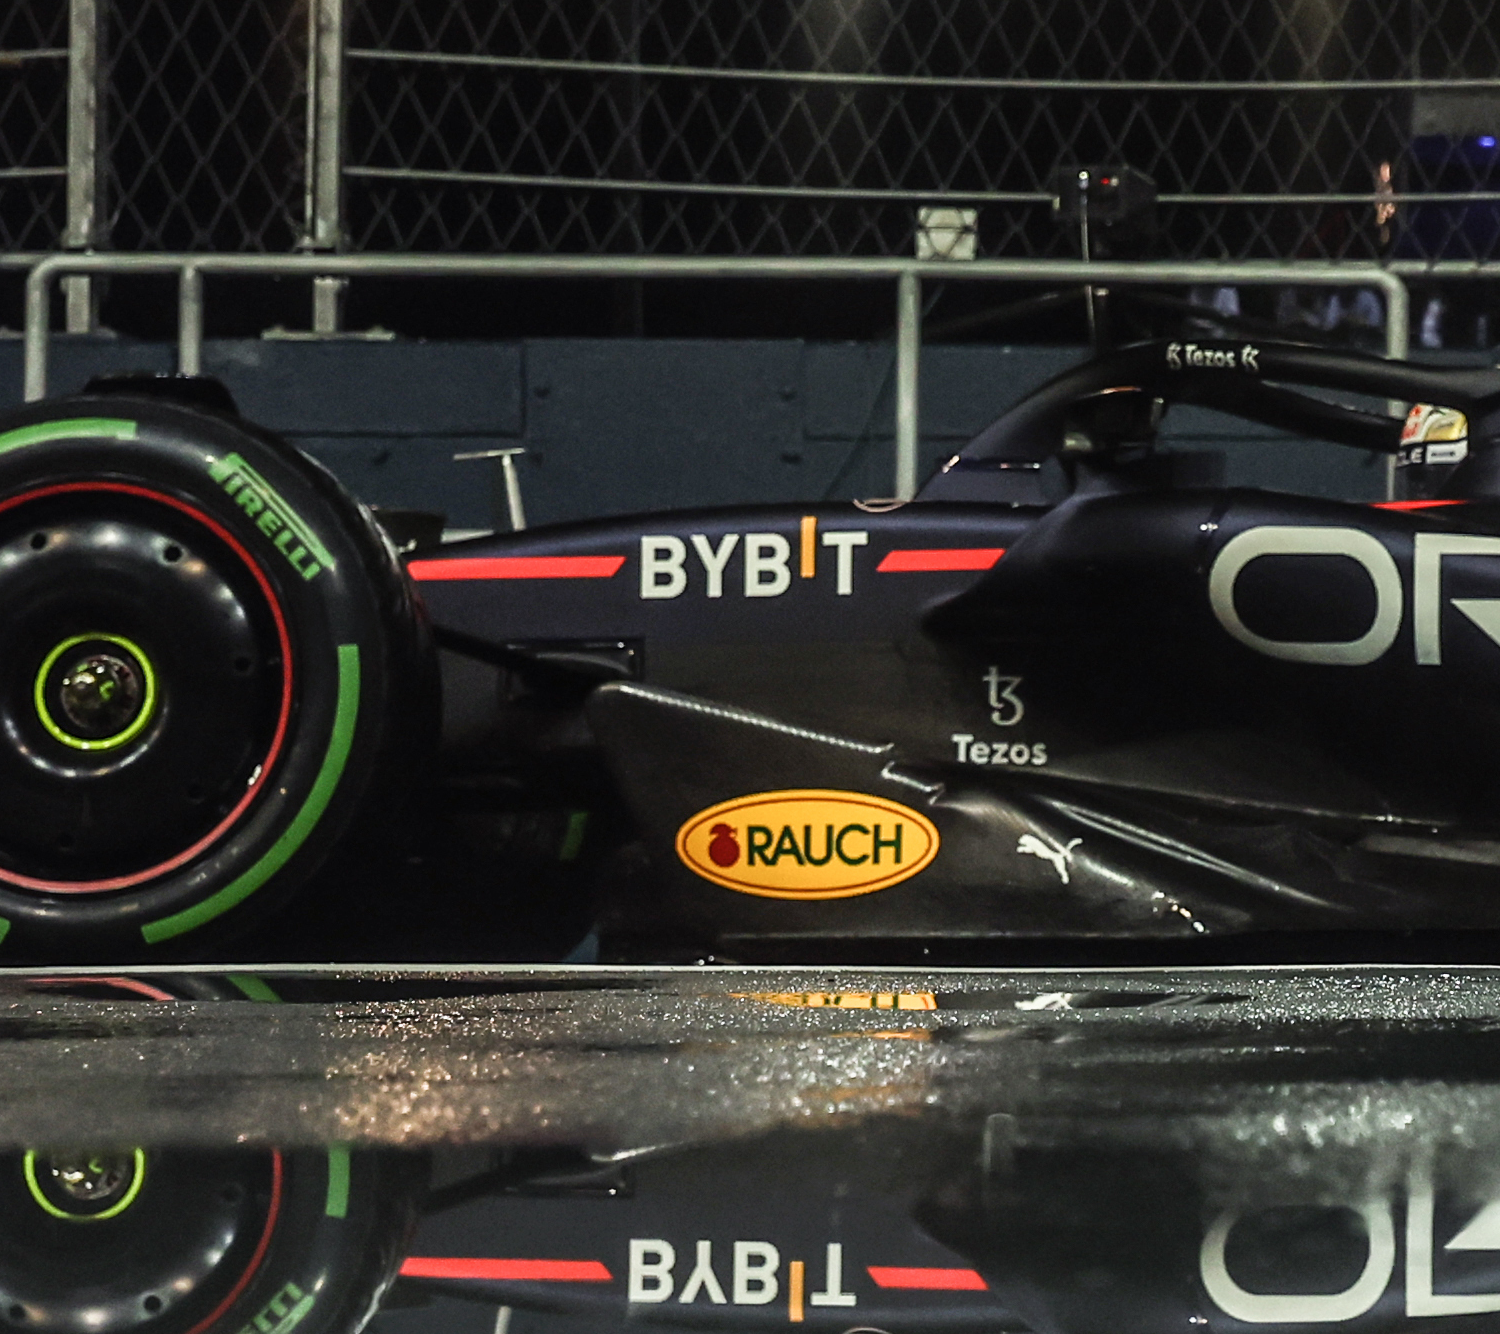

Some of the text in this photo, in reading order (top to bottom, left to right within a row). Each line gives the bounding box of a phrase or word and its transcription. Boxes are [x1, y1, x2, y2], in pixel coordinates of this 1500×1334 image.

[207, 451, 336, 581] PIRELLI
[639, 515, 869, 599] BYBIT
[951, 733, 1048, 767] Tezos
[746, 823, 903, 868] RAUCH
